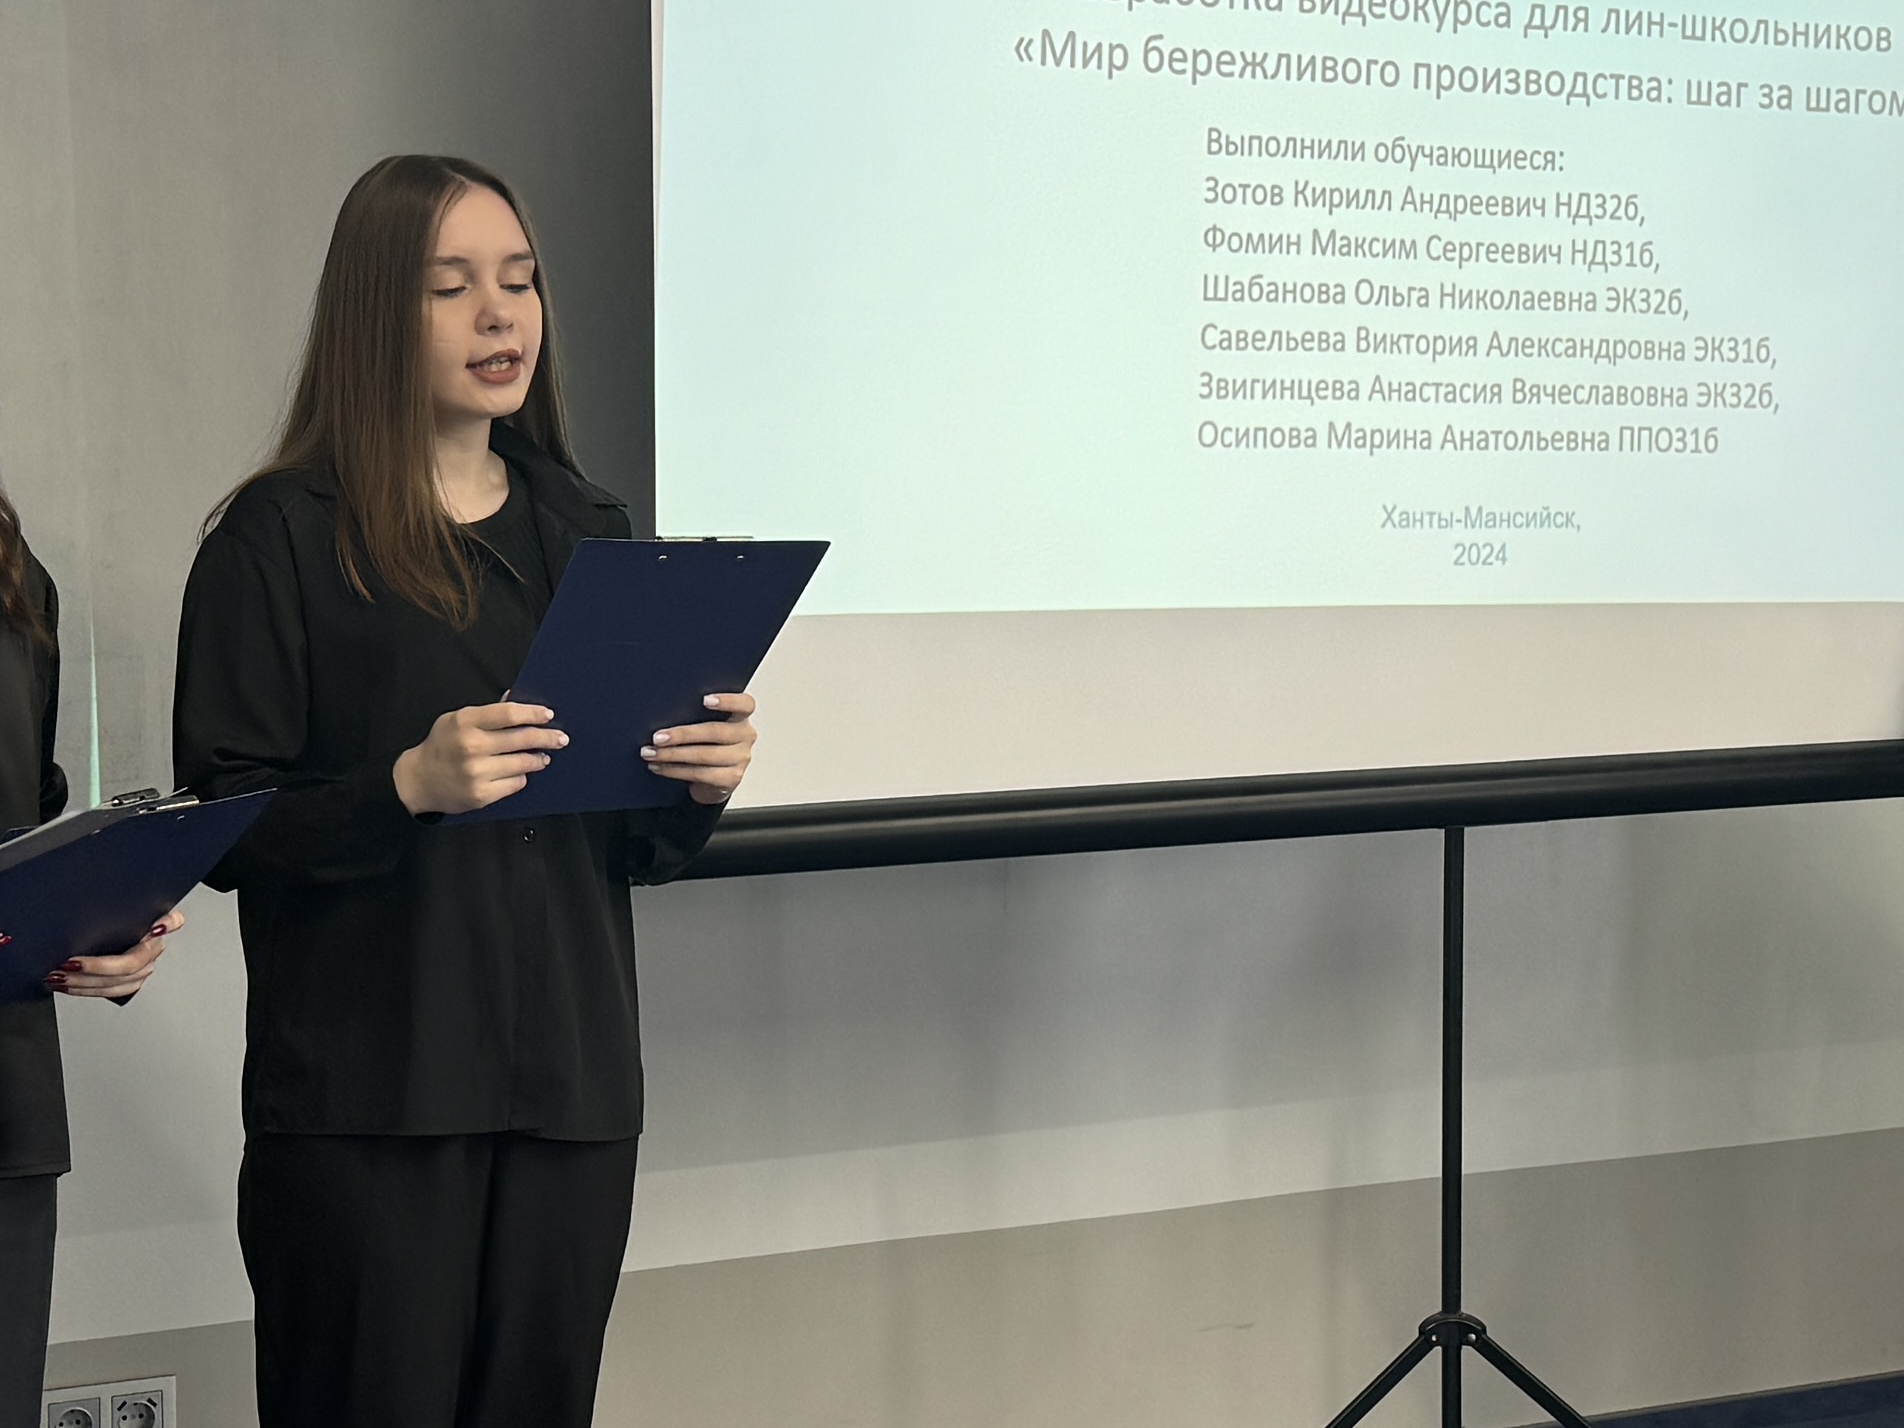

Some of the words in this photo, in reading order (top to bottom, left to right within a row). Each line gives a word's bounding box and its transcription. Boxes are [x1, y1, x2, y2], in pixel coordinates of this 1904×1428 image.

[1522, 3, 1590, 40] для
[1600, 7, 1892, 53] лин-школьников
[1014, 28, 1129, 81] «Мир
[1142, 33, 1401, 88] бережливого
[1413, 62, 1674, 108] производства:
[1686, 78, 1749, 109] шаг
[1758, 83, 1793, 111] за
[1206, 126, 1366, 162] Выполнили
[1373, 135, 1565, 175] обучающиеся:
[1203, 175, 1285, 207] Зотов
[1293, 179, 1393, 217] Кирилл
[1399, 185, 1547, 222] Андреевич
[1203, 223, 1302, 256] Фомин
[1311, 227, 1418, 261] Максим
[1425, 234, 1562, 270] Сергеевич
[1202, 273, 1346, 305] Шабанова
[1354, 277, 1430, 309] Ольга
[1439, 282, 1598, 313] Николаевна
[1200, 322, 1346, 353] Савельева
[1355, 325, 1478, 364] Виктория
[1485, 330, 1686, 367] Александровна
[1198, 371, 1360, 407] Звигинцева
[1367, 374, 1503, 405] Анастасия
[1511, 377, 1689, 408] Вячеславовна
[1197, 420, 1318, 450] Осипова
[1327, 420, 1433, 457] Марина
[1439, 423, 1610, 452] Анатольевна
[1380, 504, 1582, 532] Ханты-Мансийск,
[1452, 542, 1508, 567] 2024
